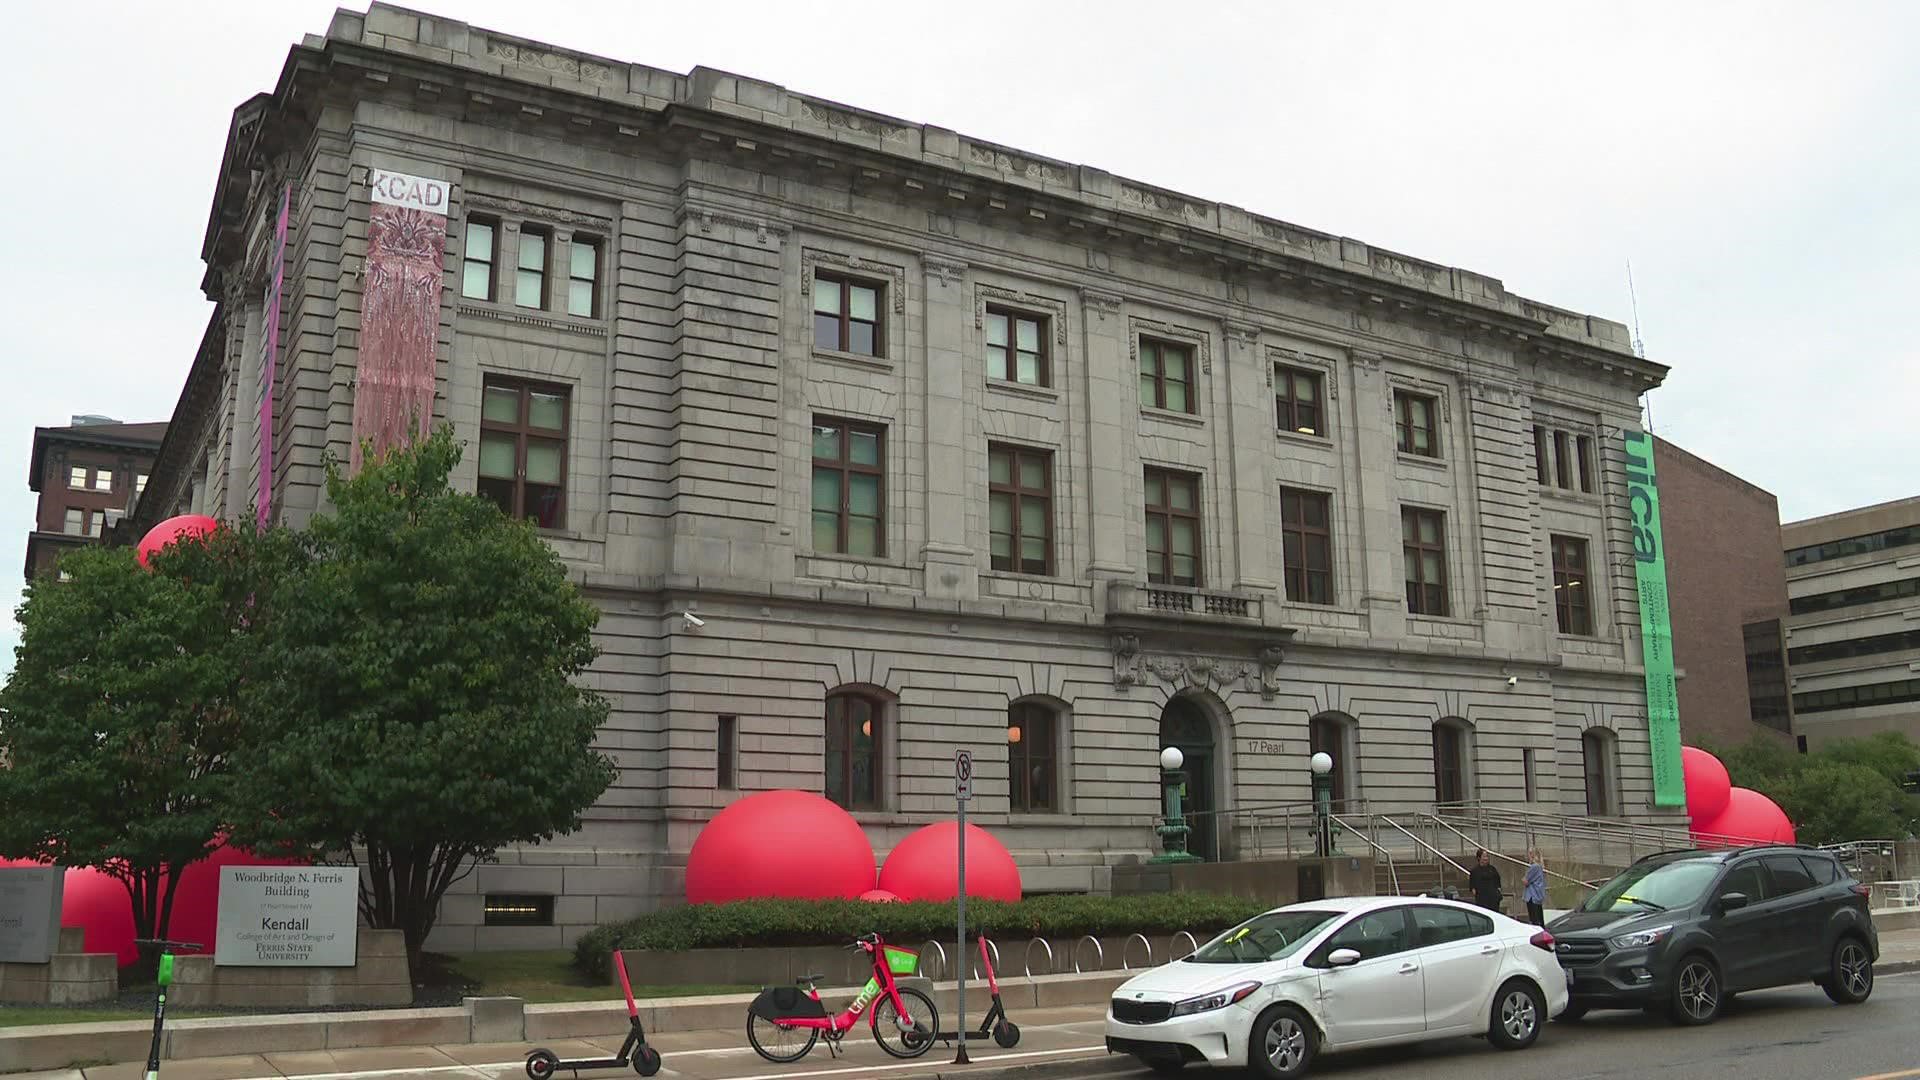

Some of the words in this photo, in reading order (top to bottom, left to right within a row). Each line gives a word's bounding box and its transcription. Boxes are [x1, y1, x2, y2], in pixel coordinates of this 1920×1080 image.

[1248, 741, 1259, 752] 17
[1260, 741, 1284, 752] Pearl
[235, 872, 296, 885] Woodbridge
[298, 873, 310, 883] N.
[313, 873, 343, 883] Ferris
[265, 885, 310, 898] Building
[262, 917, 309, 931] Kendall
[236, 932, 263, 942] College
[264, 932, 270, 940] of
[272, 932, 286, 940] Art
[301, 933, 325, 942] Design
[256, 943, 285, 952] FERRIS
[287, 943, 313, 952] STATE
[258, 952, 310, 961] UNIVERSITY
